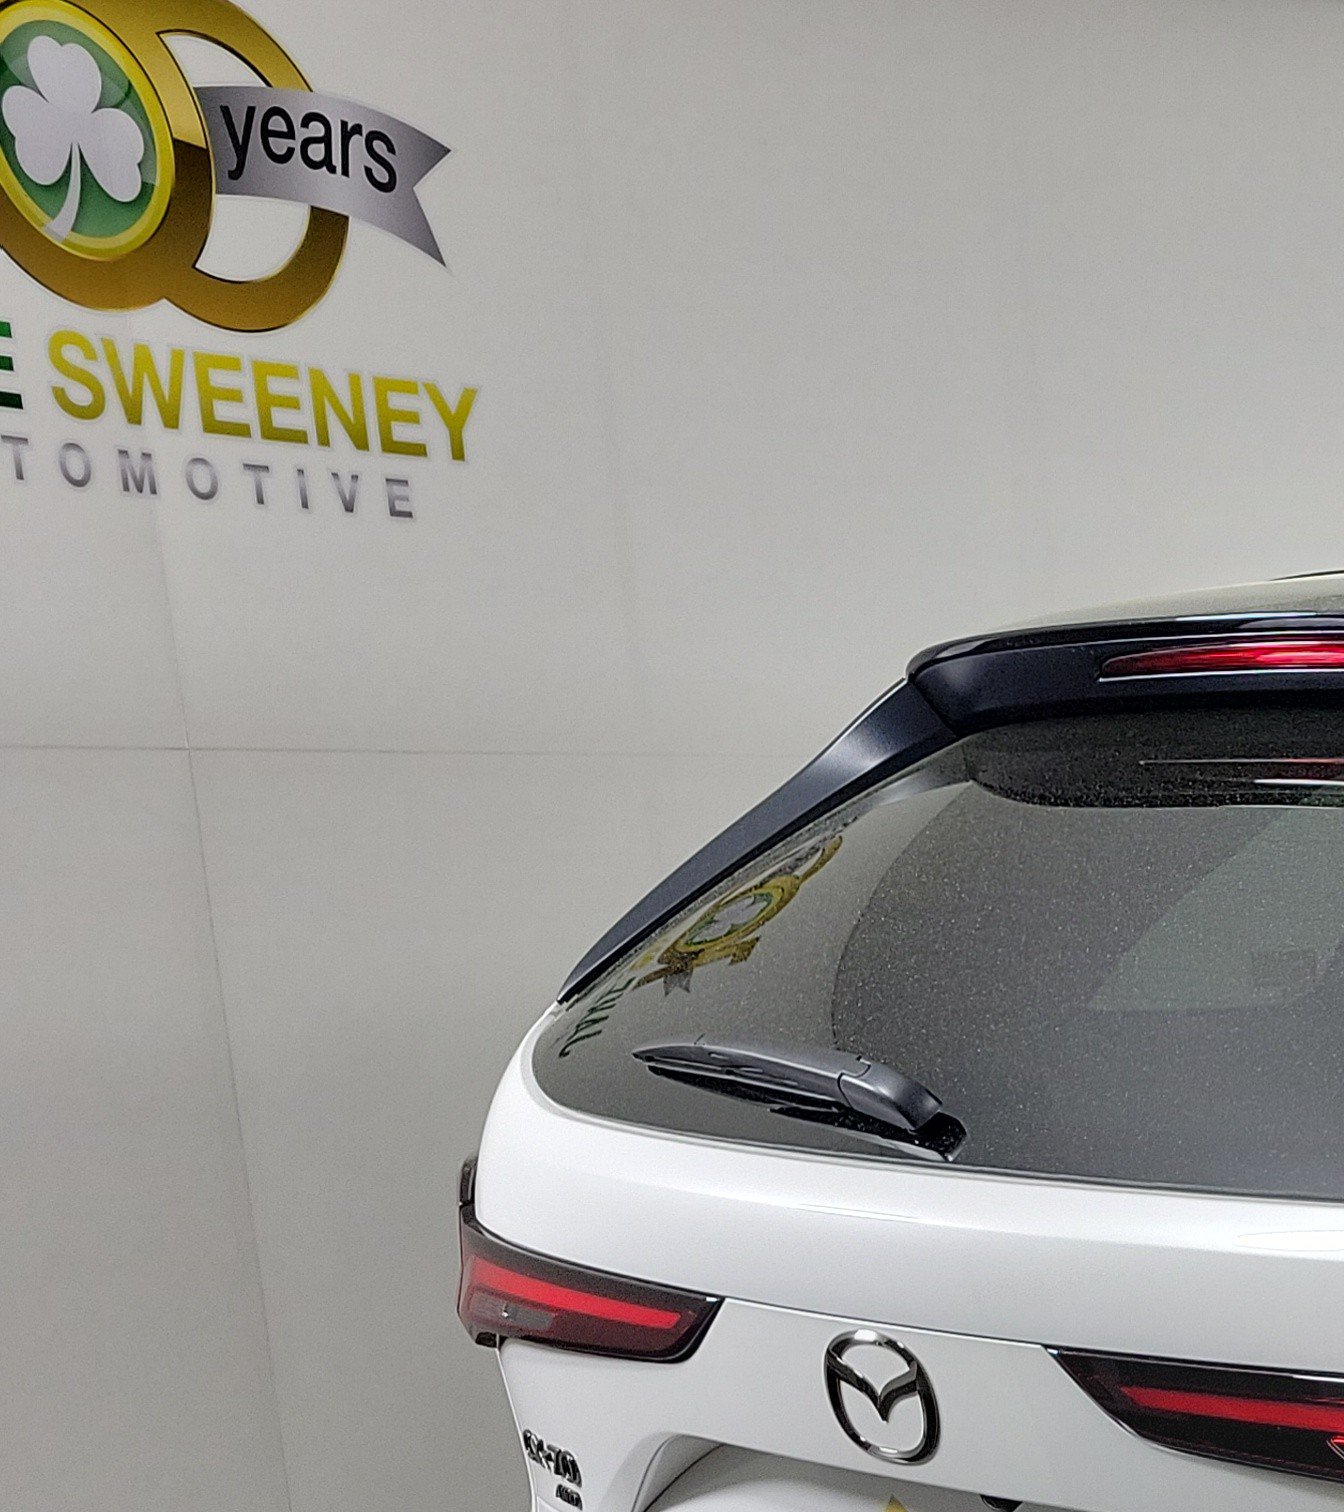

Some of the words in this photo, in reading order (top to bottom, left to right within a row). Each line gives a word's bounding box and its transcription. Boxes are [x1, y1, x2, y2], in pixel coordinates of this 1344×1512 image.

[220, 103, 399, 194] years
[47, 329, 478, 462] SWEENEY
[0, 433, 414, 519] TOMOTIVE
